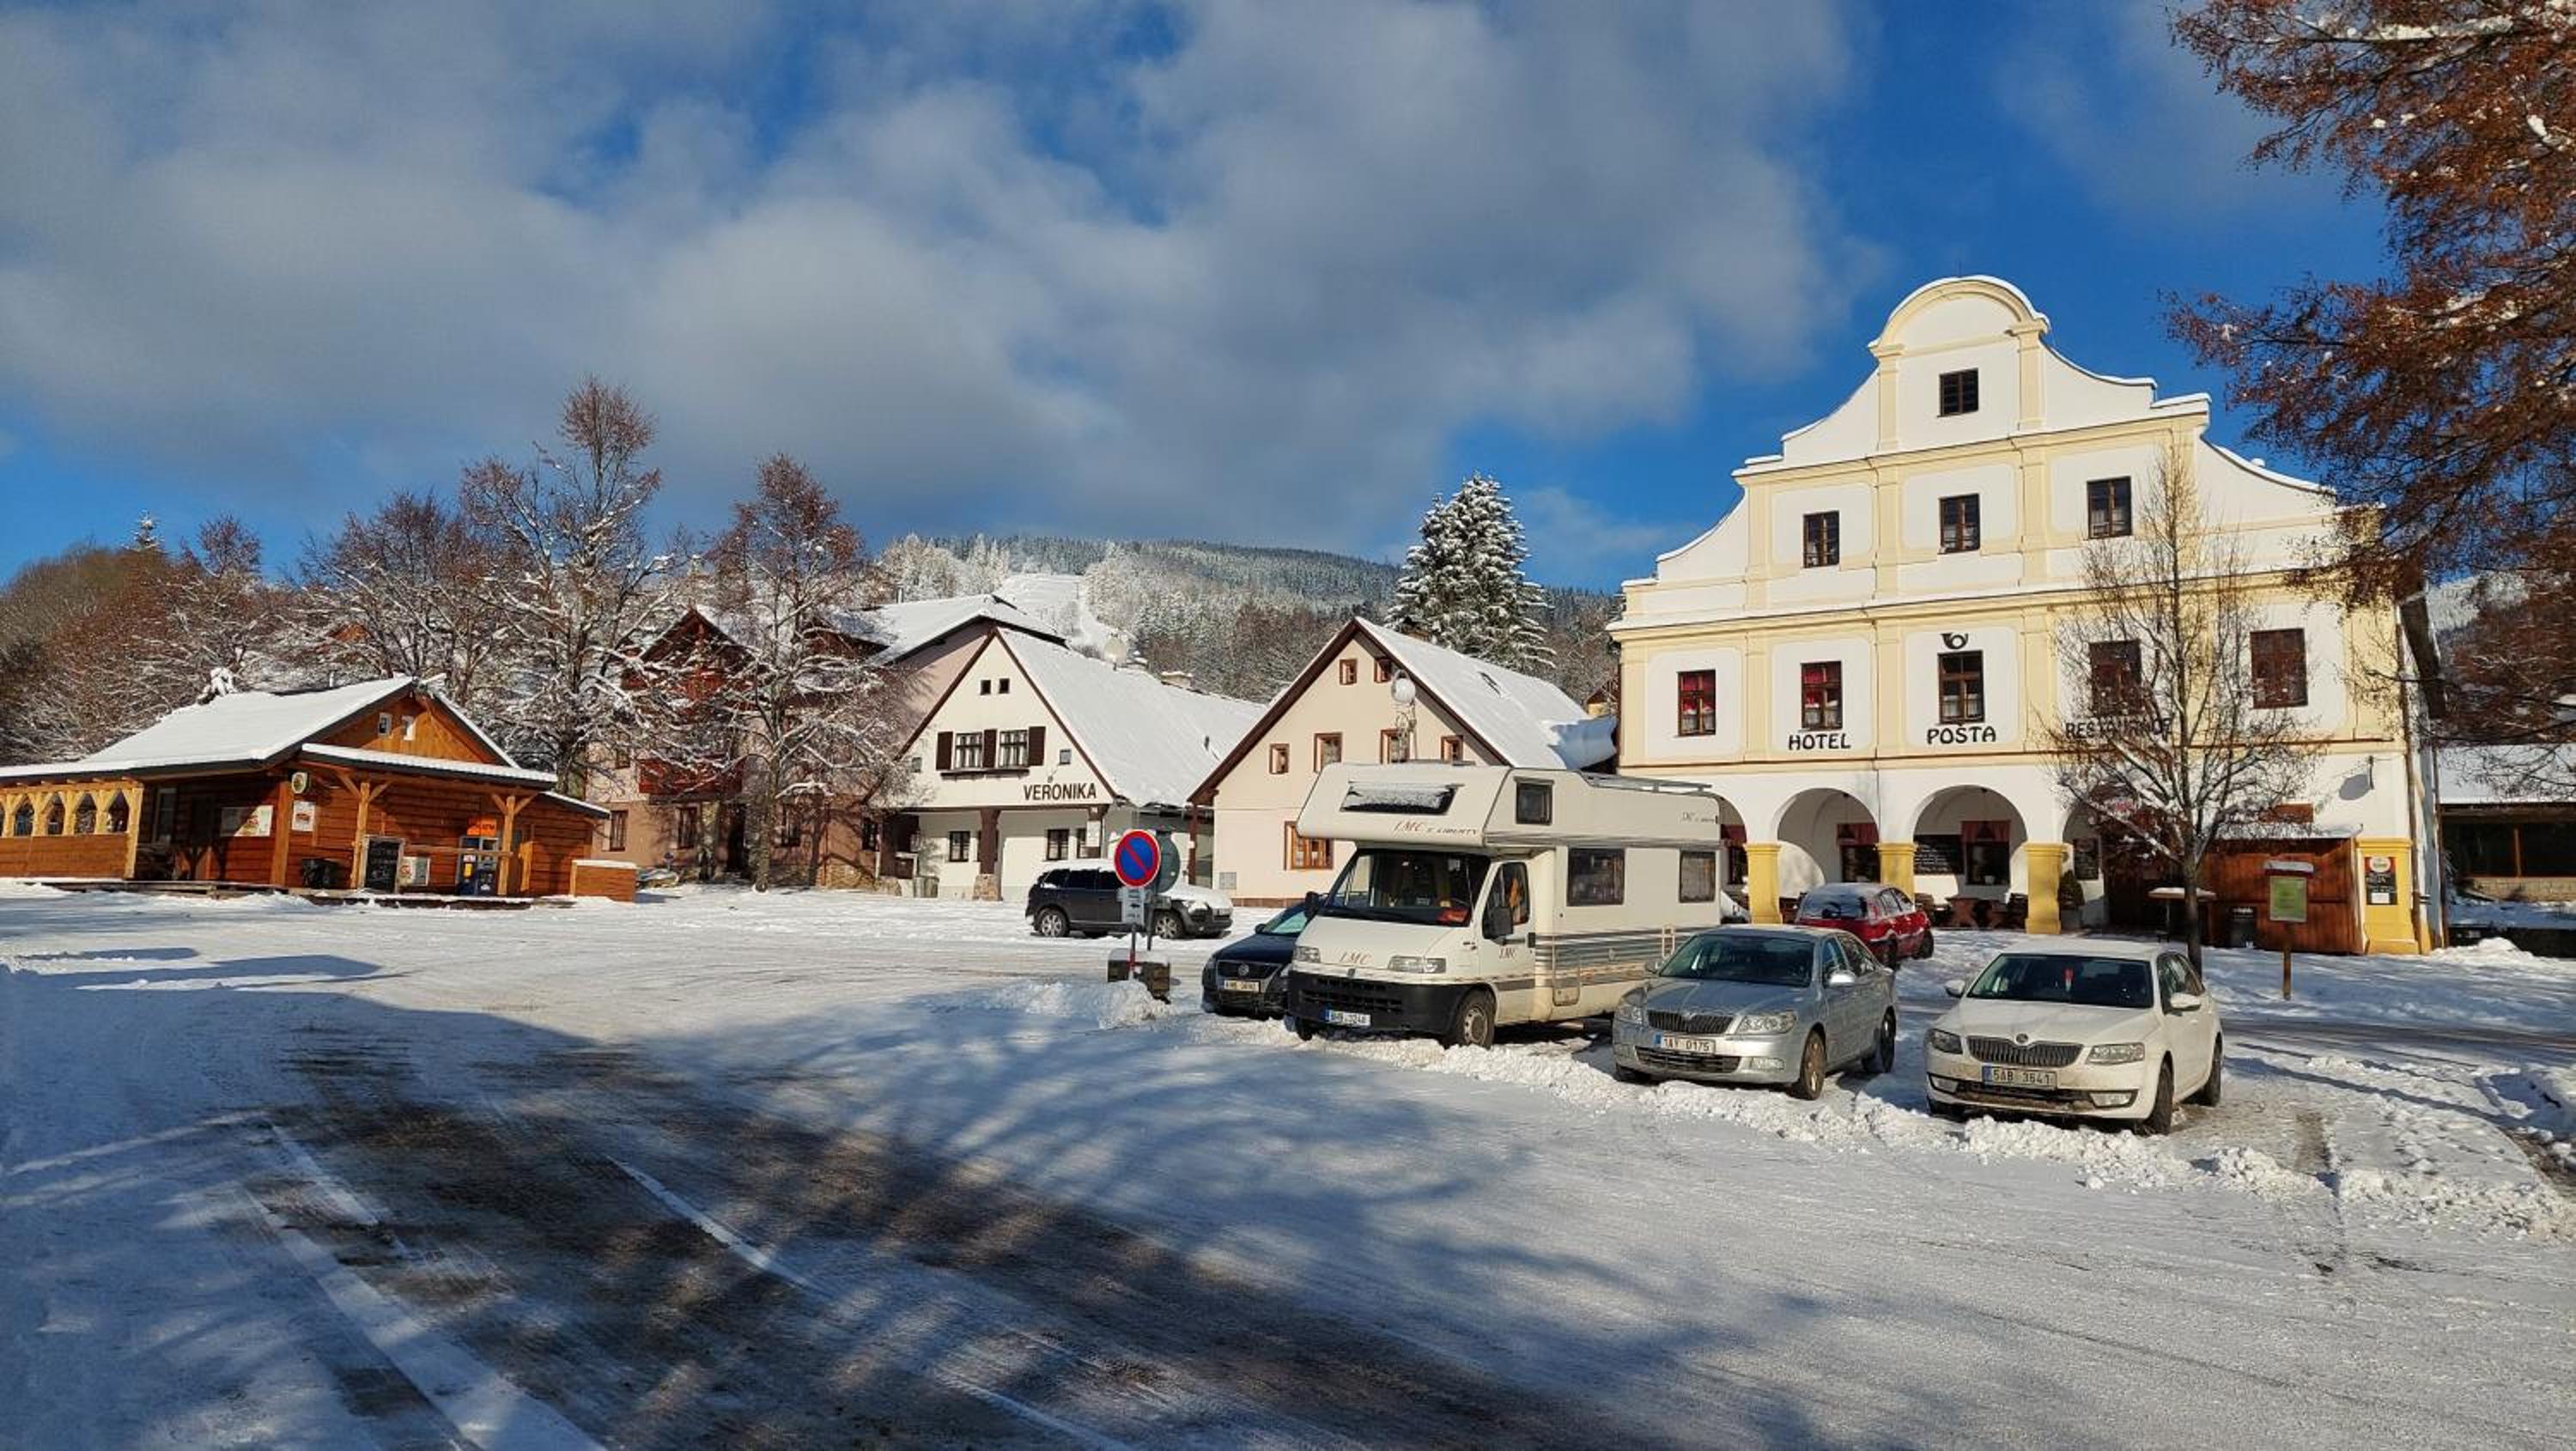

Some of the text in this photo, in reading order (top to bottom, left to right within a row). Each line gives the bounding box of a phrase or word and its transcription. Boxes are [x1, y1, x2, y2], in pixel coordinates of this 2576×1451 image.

[1788, 722, 1997, 750] HOTEL POŠTA
[1023, 783, 1097, 800] VERONIKA
[1686, 1039, 1710, 1052] 0175
[1993, 1068, 2014, 1082] 5AB
